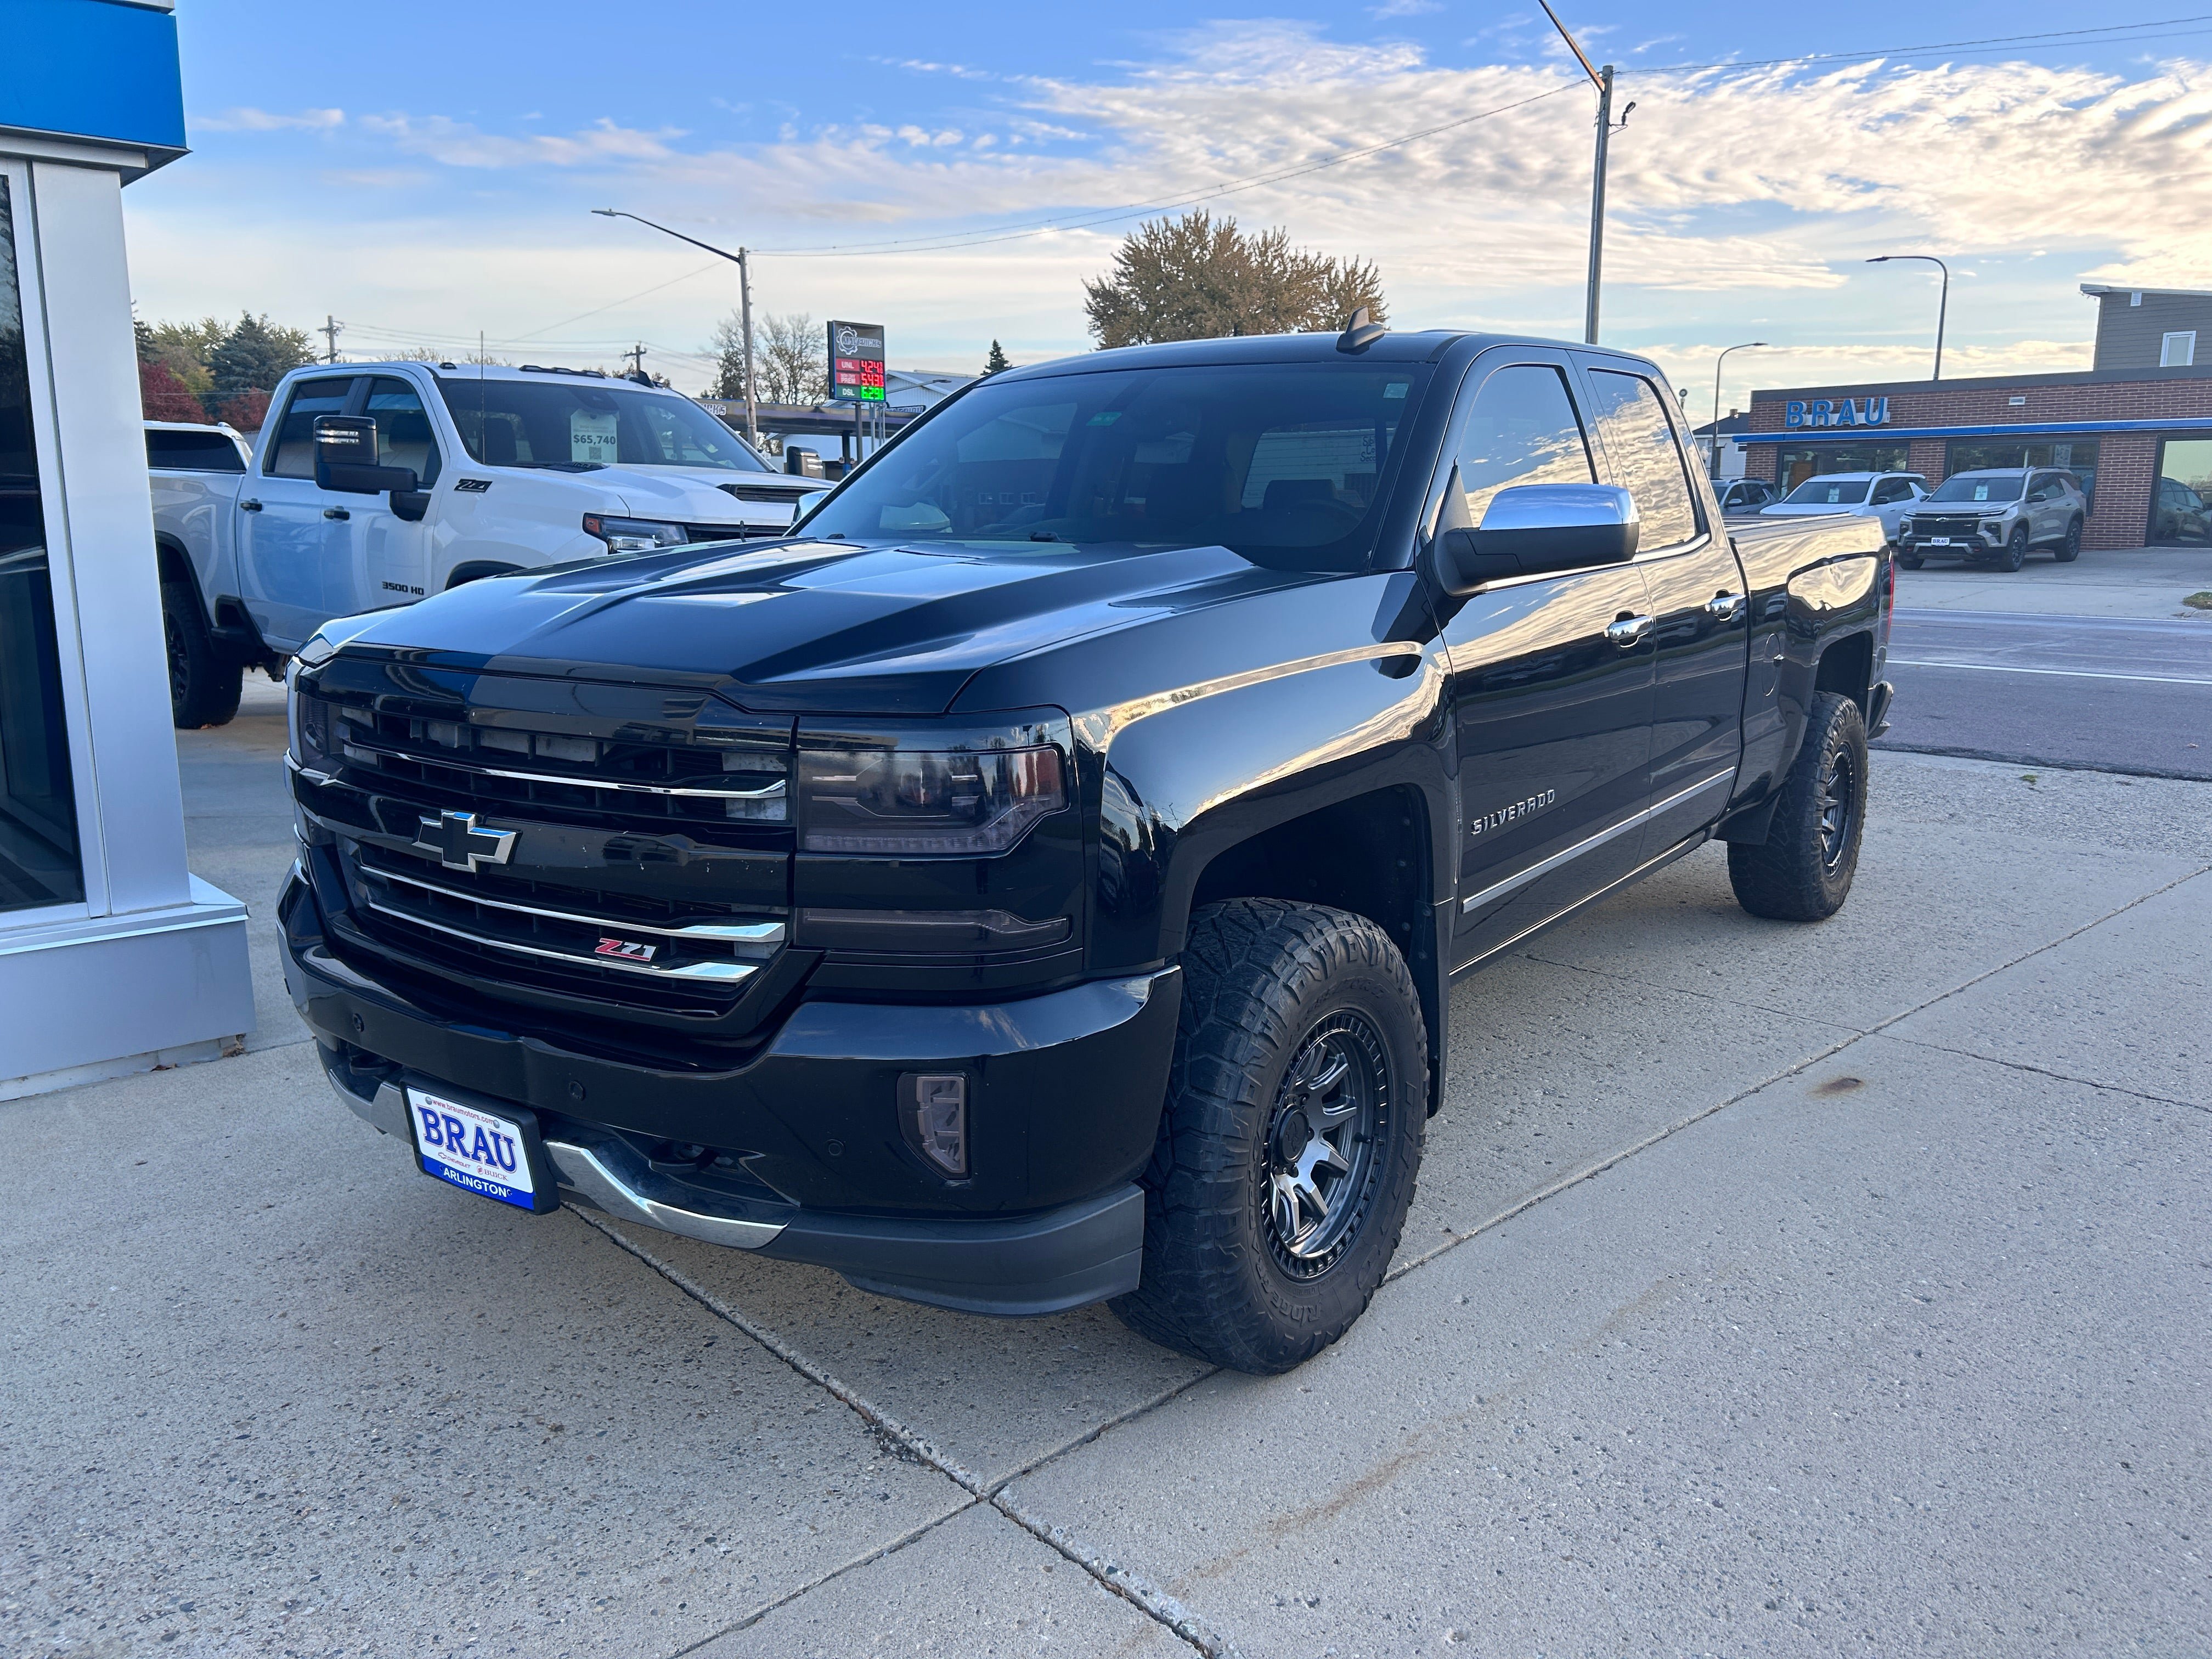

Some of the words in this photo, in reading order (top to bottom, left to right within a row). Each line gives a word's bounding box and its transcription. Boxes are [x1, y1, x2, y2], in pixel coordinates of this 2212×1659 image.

[1785, 397, 1888, 428] BRAU
[573, 435, 616, 445] $65,740
[382, 582, 408, 592] 3500
[411, 586, 424, 595] HD
[1471, 789, 1555, 836] SILVERADO
[595, 938, 656, 962] Z71
[432, 1099, 494, 1125] www.braumotors.com
[416, 1104, 517, 1173] BRAU
[447, 1155, 471, 1169] CHEVROLET
[484, 1169, 509, 1181] BUICK
[444, 1167, 507, 1198] ARLINGTON
